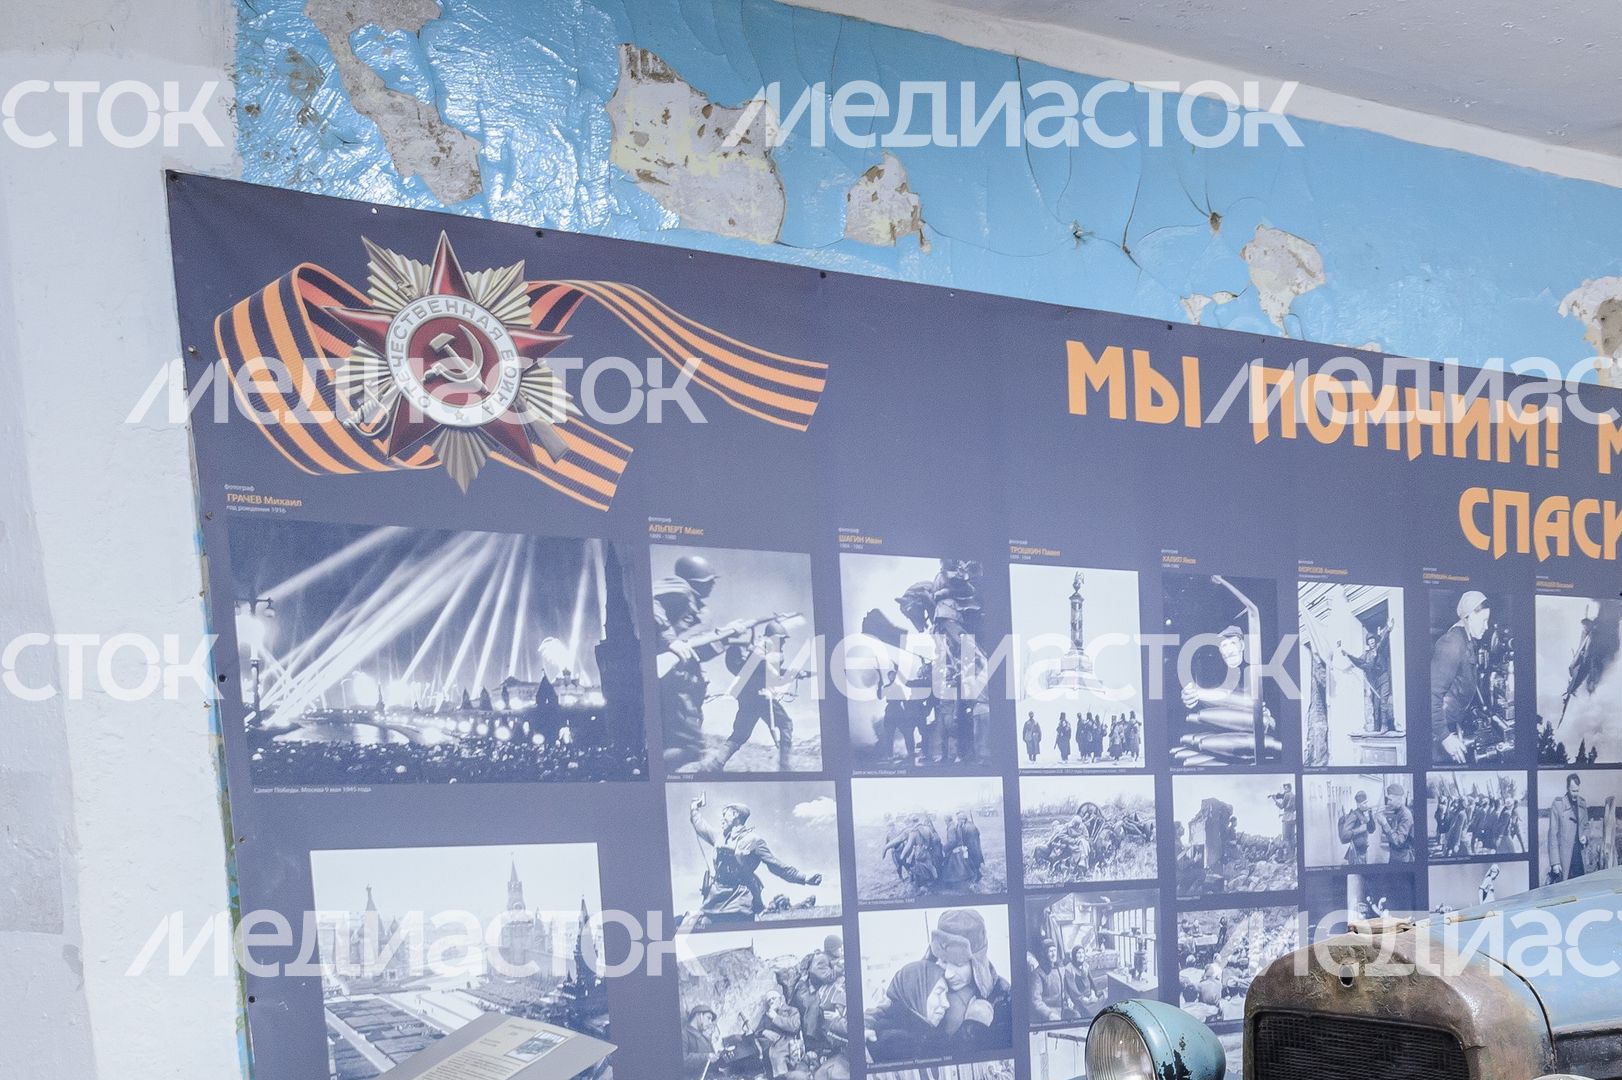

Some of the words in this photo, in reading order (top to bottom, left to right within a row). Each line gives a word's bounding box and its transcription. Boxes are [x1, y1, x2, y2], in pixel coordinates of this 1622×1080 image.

[391, 299, 504, 409] ОТЕЧЕСТВЕННАЯ
[1065, 339, 1201, 429] МЫ
[1250, 365, 1560, 469] ПОМНИМ!
[226, 493, 262, 505] ГРАЧЕВ
[264, 496, 303, 507] Михаил
